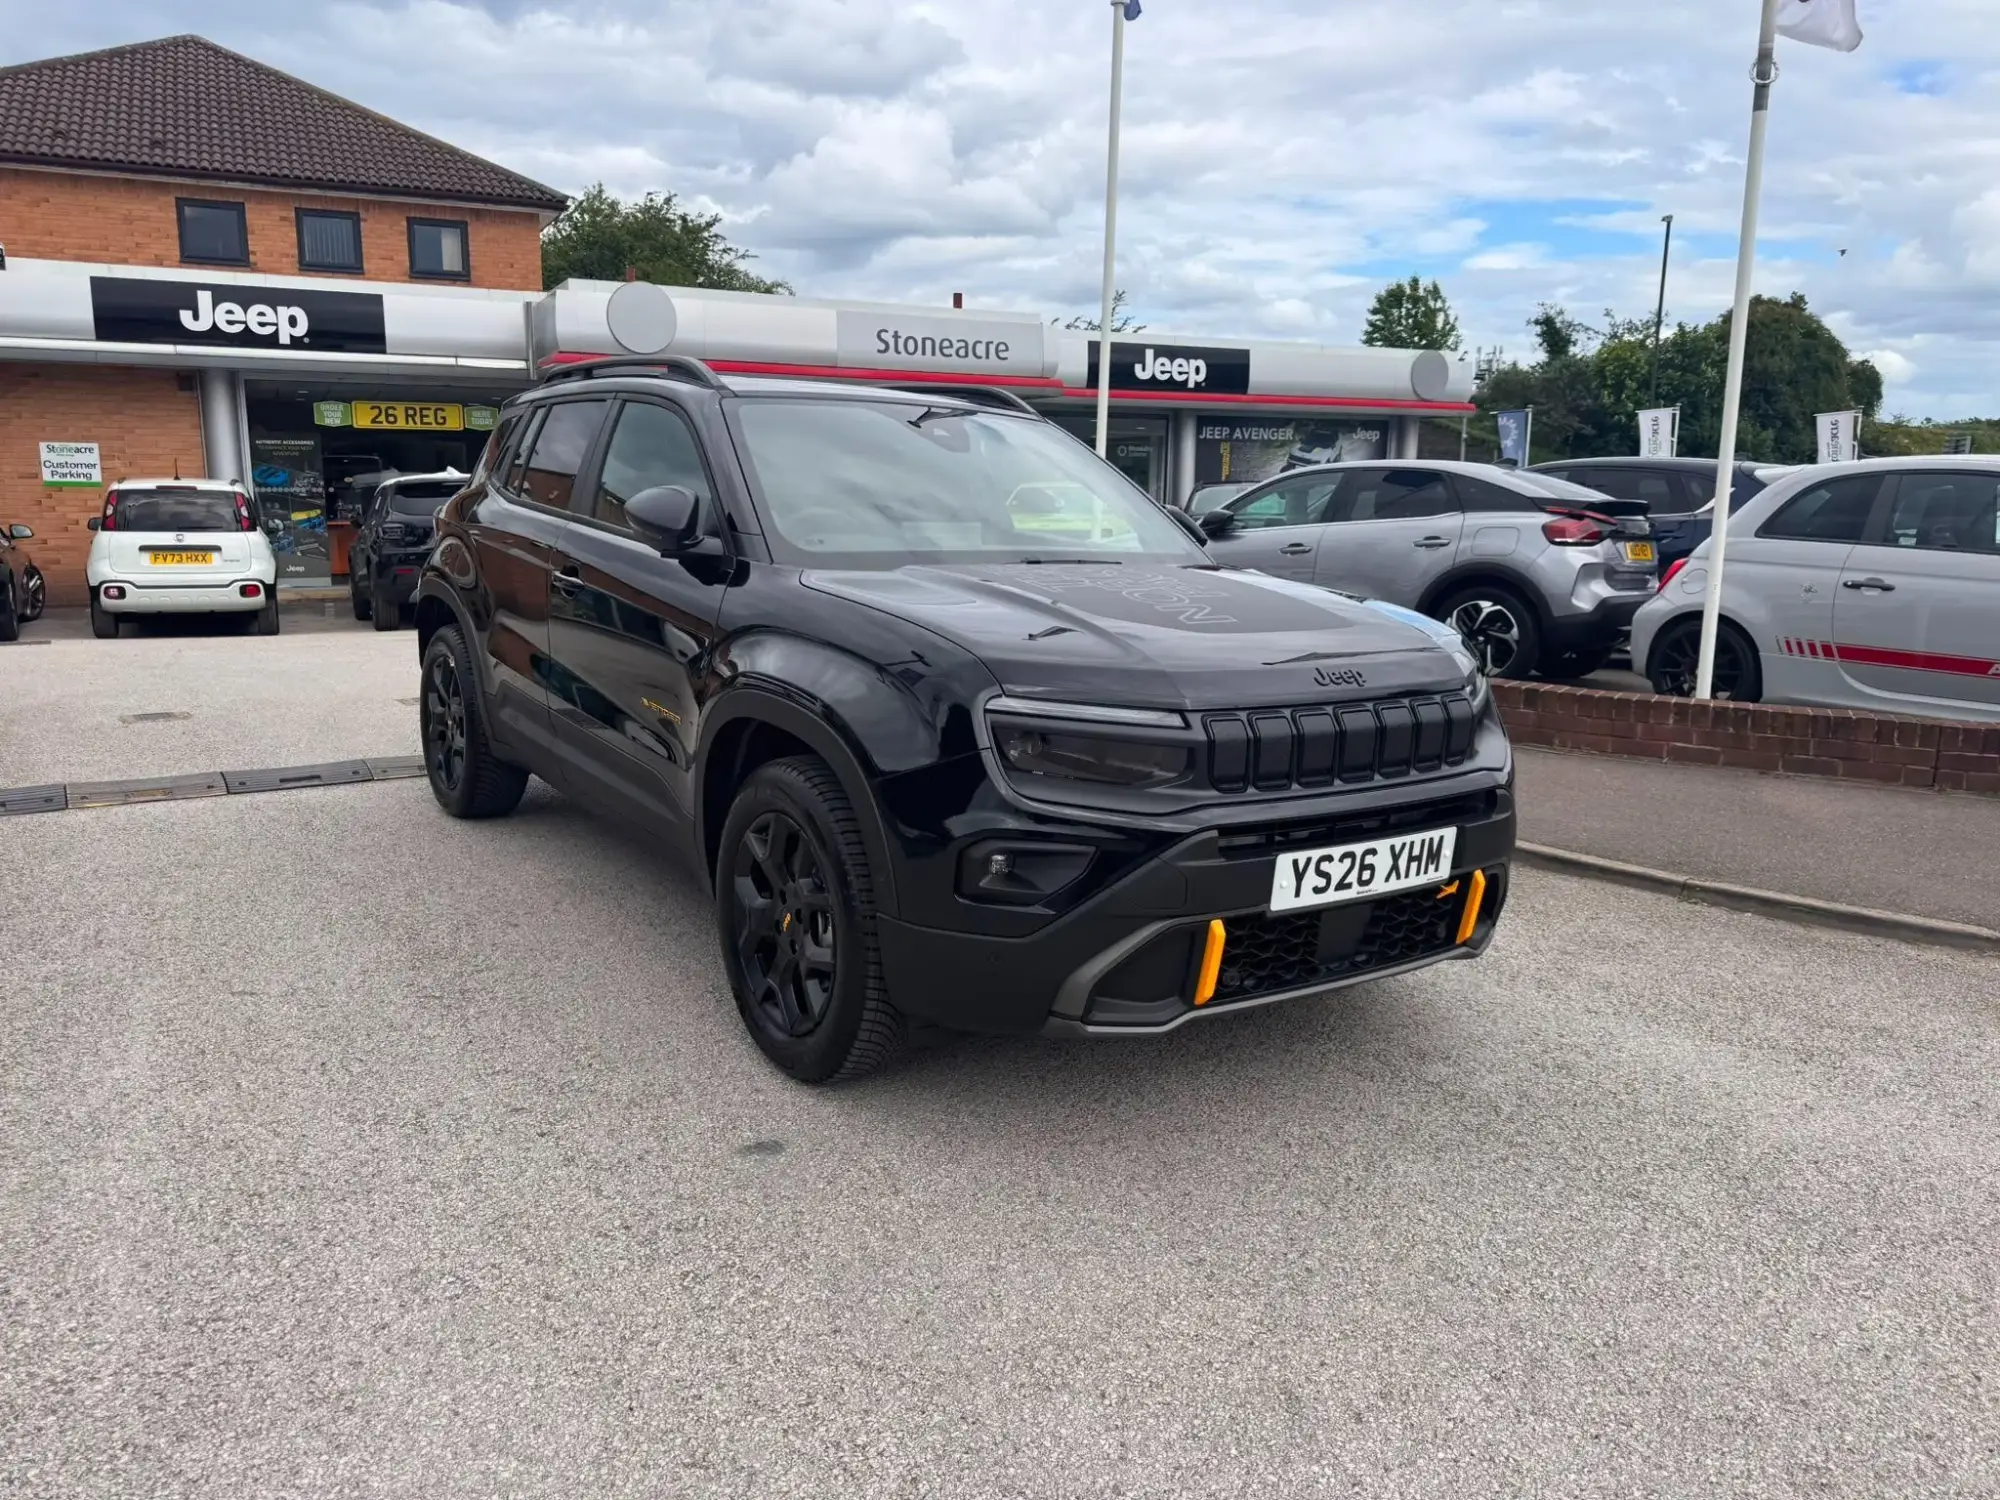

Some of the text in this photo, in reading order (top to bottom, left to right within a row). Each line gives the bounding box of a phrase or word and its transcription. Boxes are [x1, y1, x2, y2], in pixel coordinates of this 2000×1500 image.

[179, 290, 309, 344] Jeep
[876, 329, 1010, 361] Stoneacre
[1134, 349, 1207, 388] Jeep
[369, 405, 447, 426] 26 REG
[1199, 427, 1294, 441] JEEP AVENGER
[1352, 427, 1380, 442] Jeep
[46, 444, 95, 454] Stoneacre
[43, 460, 98, 469] Customer
[51, 470, 93, 481] Parking
[153, 553, 208, 563] FV73 HXX
[1313, 667, 1365, 687] Jeep
[1291, 834, 1445, 898] YS26 XHM
